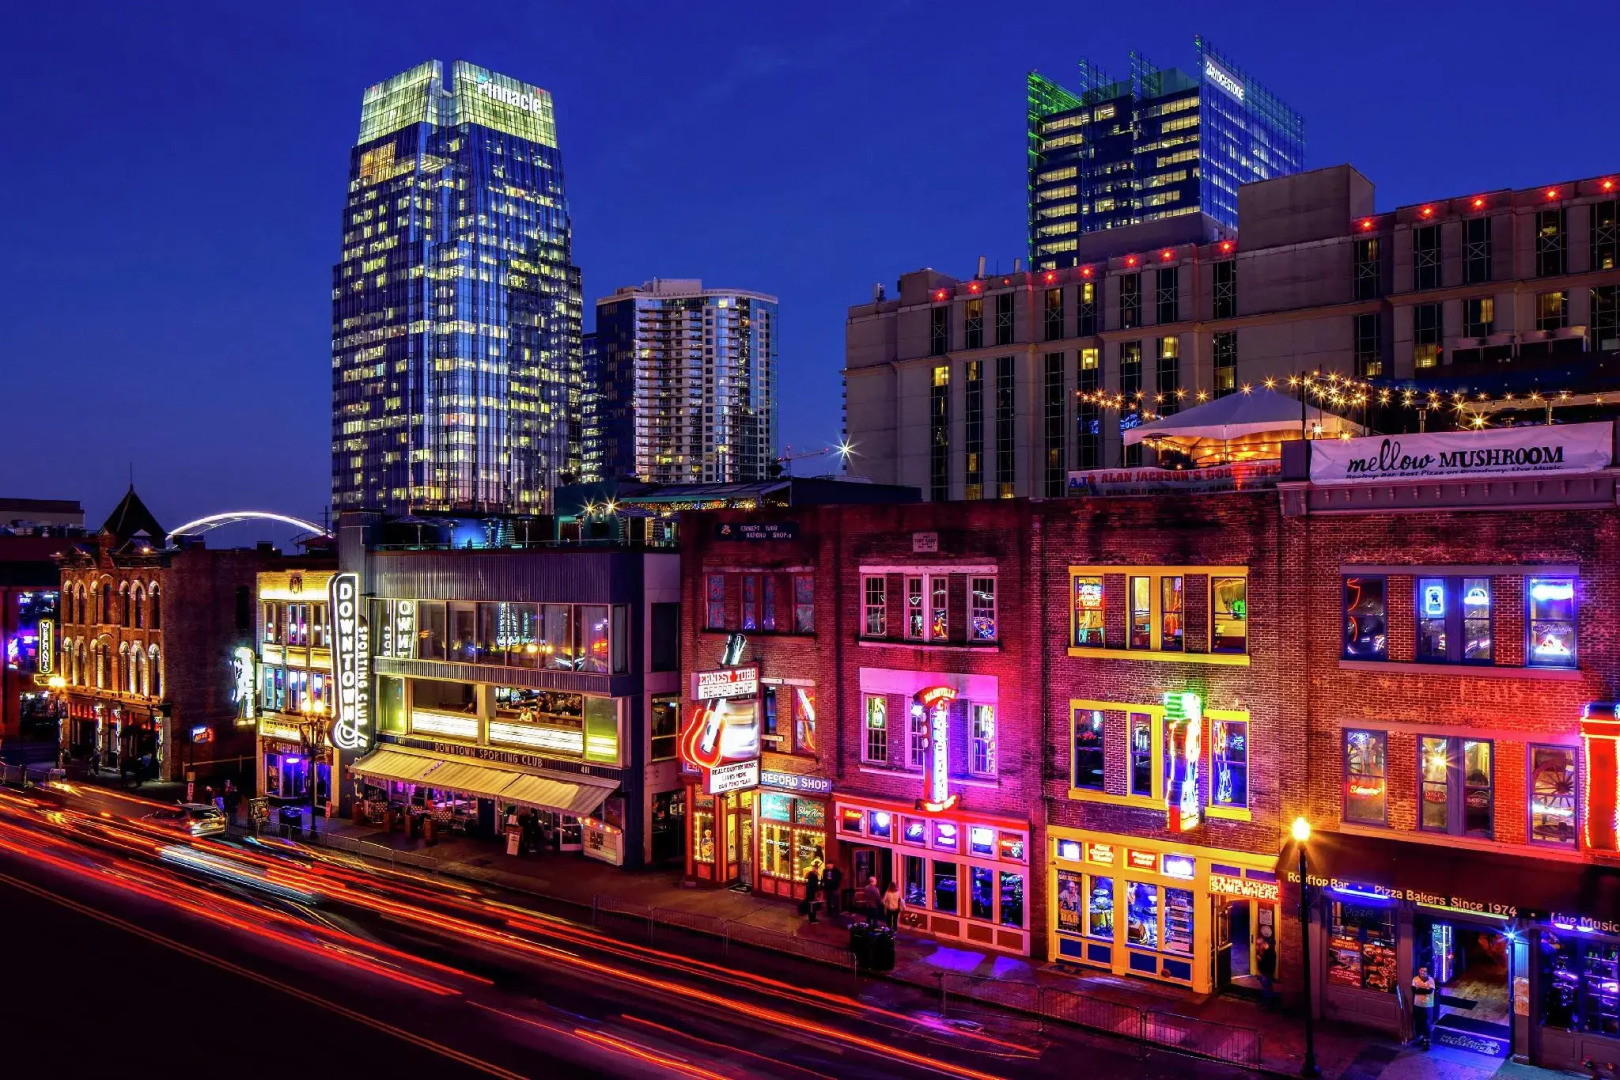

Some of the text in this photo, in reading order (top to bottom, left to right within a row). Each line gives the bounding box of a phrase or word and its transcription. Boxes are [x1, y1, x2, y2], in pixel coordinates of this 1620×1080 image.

[1346, 438, 1564, 473] mellow MUSHROOM
[1101, 472, 1132, 484] ALAN
[338, 582, 355, 722] DOWNTOWN
[357, 626, 368, 688] SPORTING
[699, 668, 756, 686] ERNEST TUBB
[703, 682, 753, 698] RECORD SHOP
[434, 742, 543, 768] DOWNTOWN SPORTING CLUB
[761, 772, 828, 791] RECORD SHOP
[1211, 881, 1279, 901] SOMEWHERE
[1287, 871, 1329, 887] Roftop
[1330, 878, 1350, 890] Bar
[1374, 885, 1403, 900] Pizza
[1406, 889, 1446, 906] Bakers
[1450, 896, 1484, 912] Since
[1488, 902, 1518, 917] 1974
[1550, 911, 1577, 926] Live
[1580, 916, 1620, 933] Music
